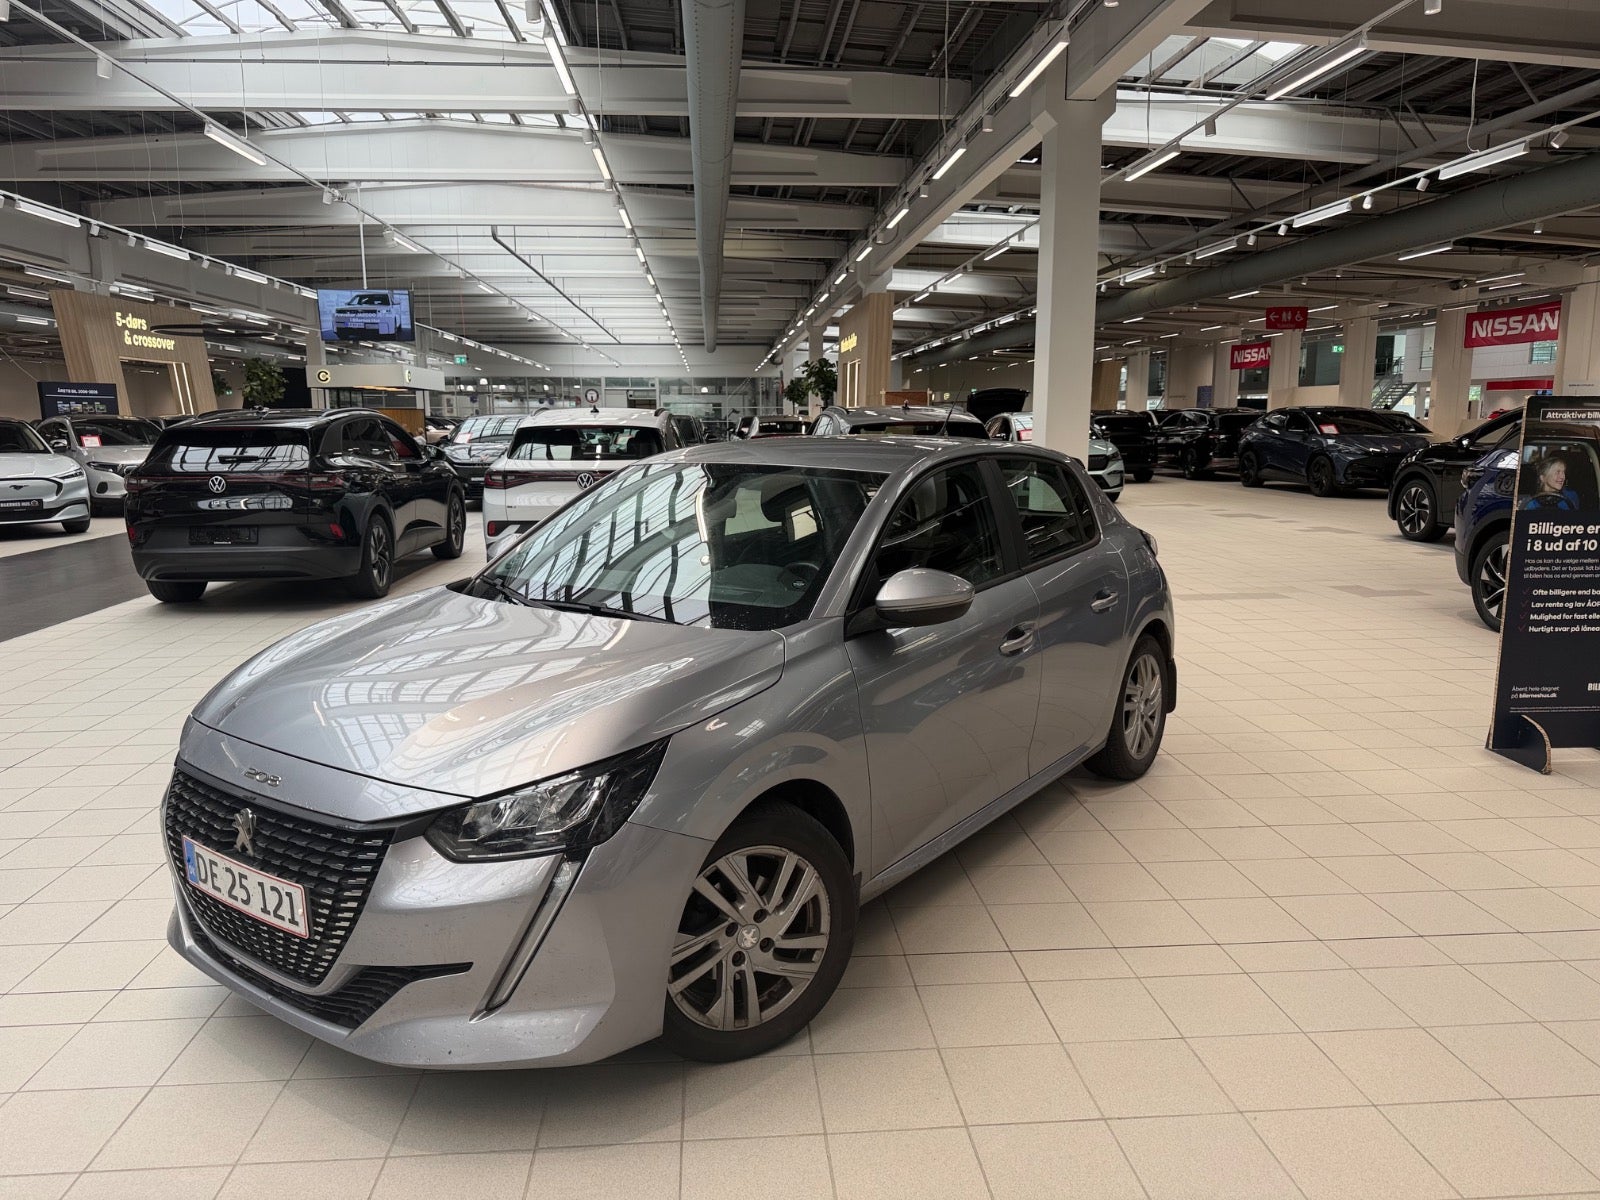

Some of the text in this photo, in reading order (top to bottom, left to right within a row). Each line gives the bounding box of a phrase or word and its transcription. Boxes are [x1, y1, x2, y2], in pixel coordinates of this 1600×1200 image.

[1471, 310, 1560, 339] NISSAN
[124, 329, 175, 350] & crossover
[1233, 346, 1272, 364] NISSAN
[1545, 411, 1587, 419] Attraktive
[1528, 521, 1585, 537] Billigere
[1526, 538, 1598, 552] i 8 ud af 10
[1549, 588, 1577, 596] billigere
[1529, 613, 1562, 622] Mulighed
[1528, 625, 1554, 634] Hurtigt
[1570, 625, 1580, 633] på
[195, 851, 300, 927] DE 25 121
